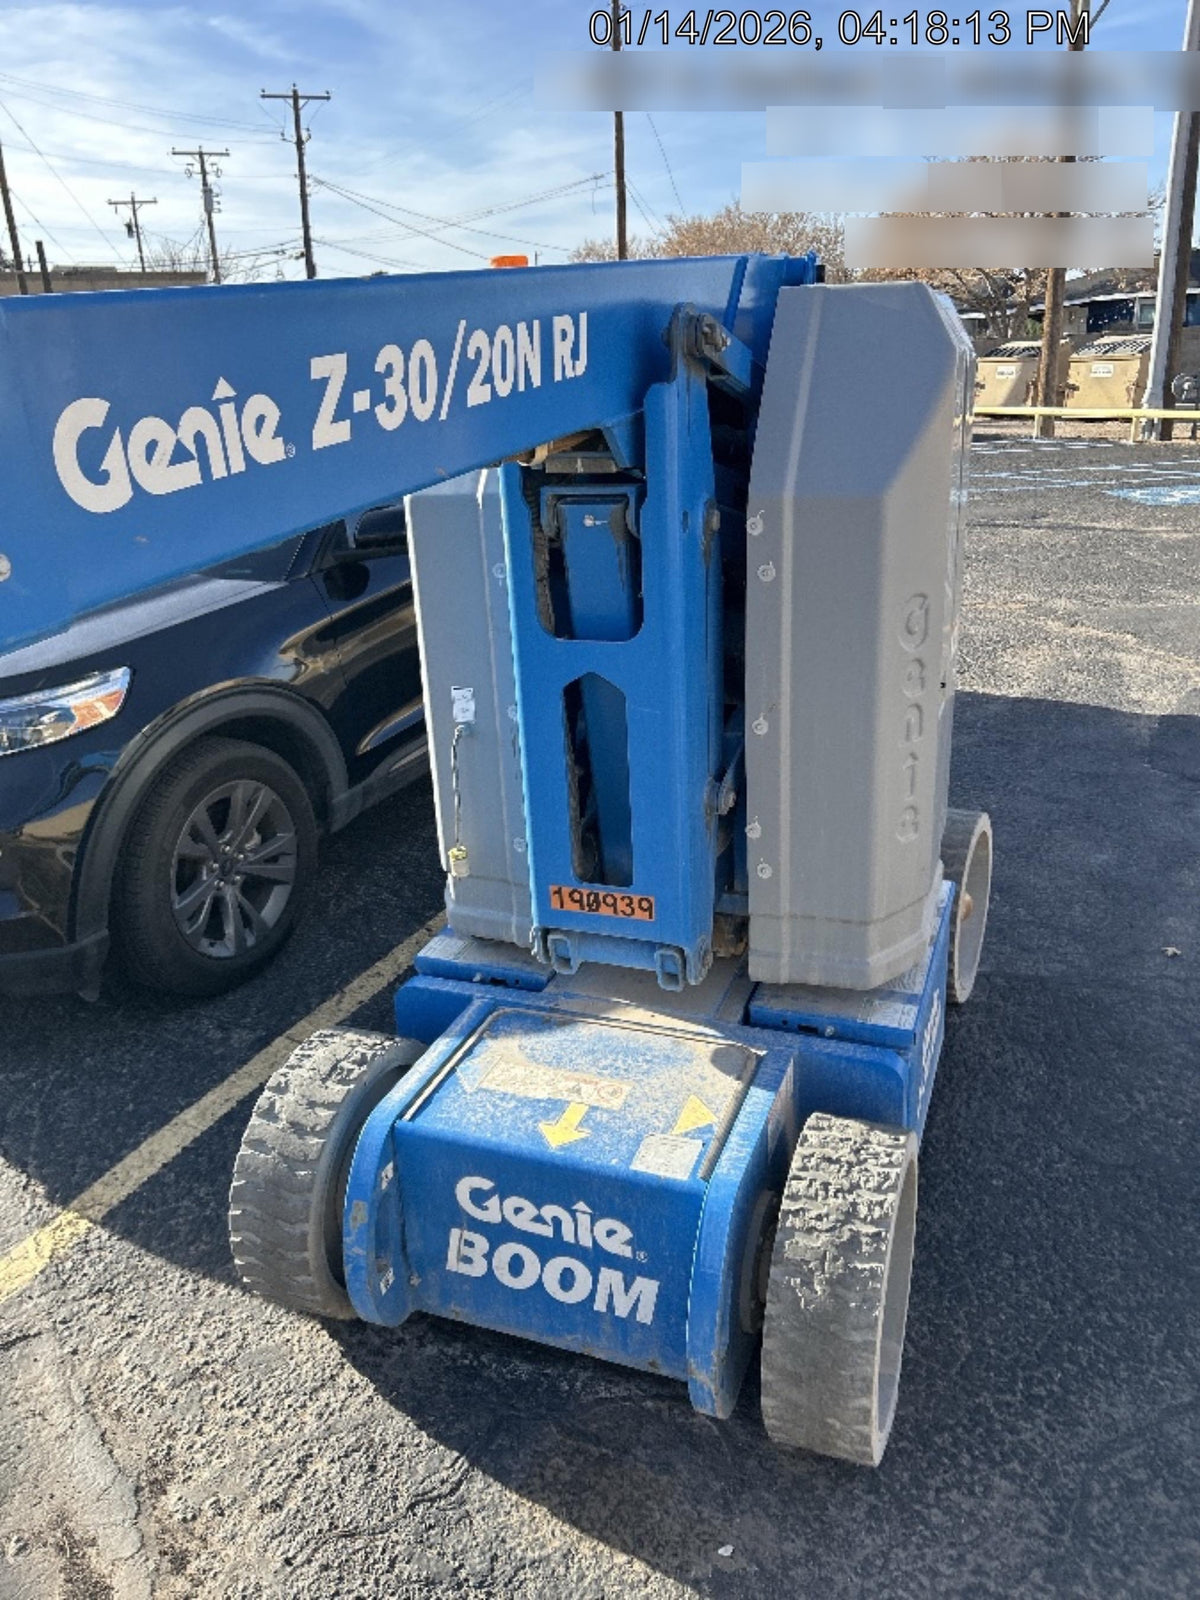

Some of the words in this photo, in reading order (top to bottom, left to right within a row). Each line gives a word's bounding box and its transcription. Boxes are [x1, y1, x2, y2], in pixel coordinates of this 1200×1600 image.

[52, 376, 286, 514] Genie
[310, 319, 542, 451] Z-30/20N
[552, 311, 588, 382] RJ
[455, 1176, 634, 1259] Genie
[445, 1228, 661, 1326] BOOM
